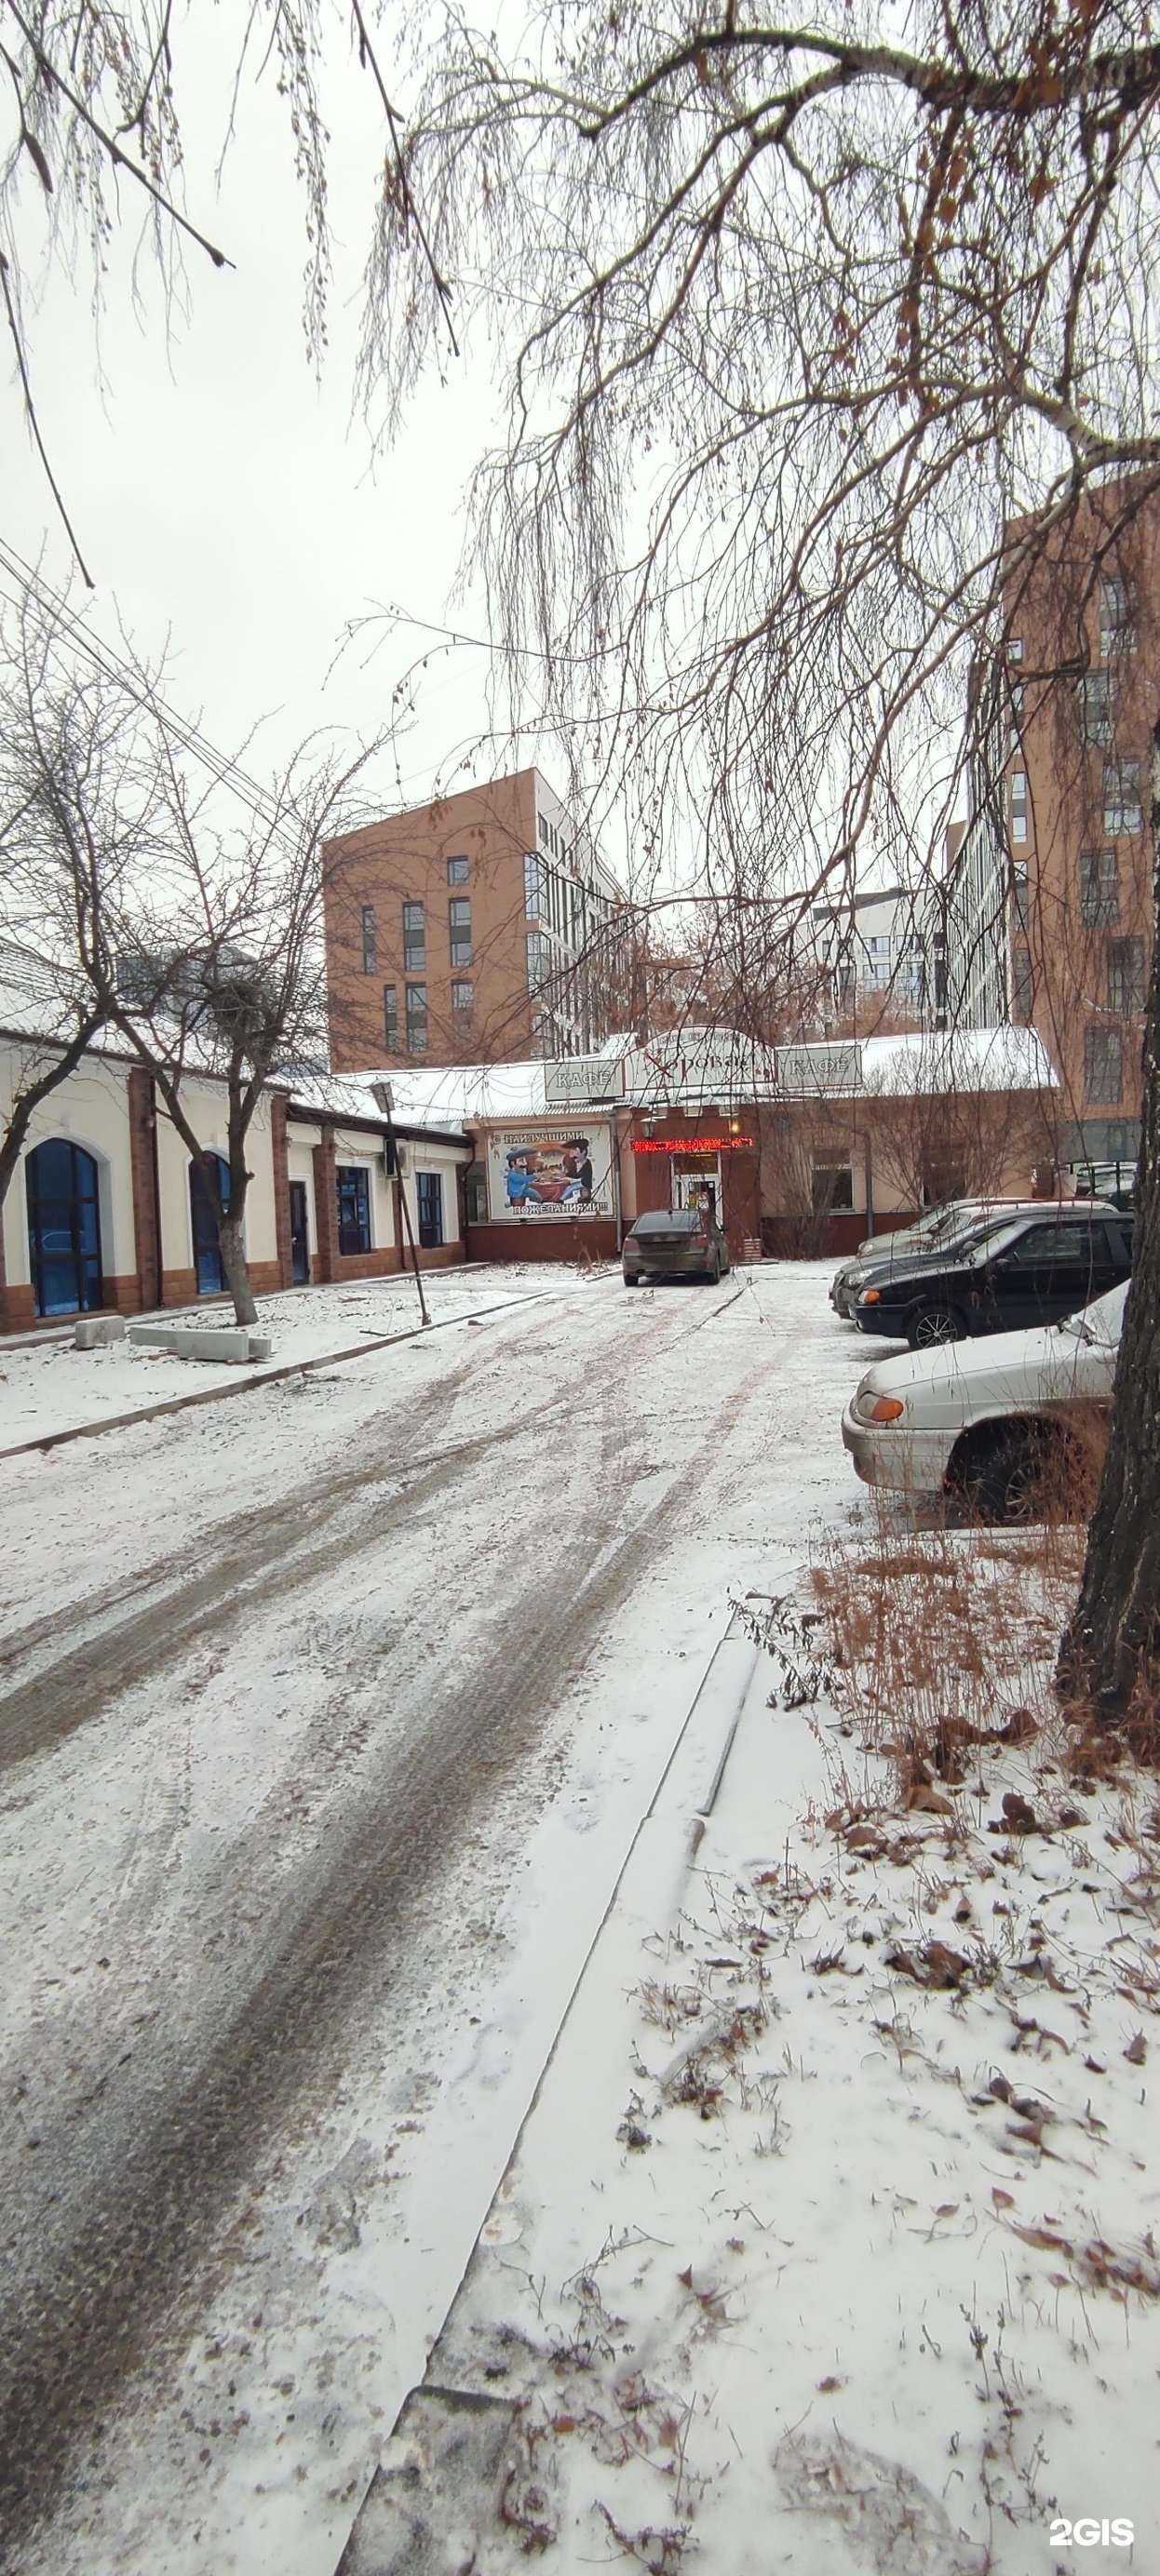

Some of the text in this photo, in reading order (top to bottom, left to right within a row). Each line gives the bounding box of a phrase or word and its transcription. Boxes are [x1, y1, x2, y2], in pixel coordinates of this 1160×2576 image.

[789, 1057, 849, 1075] КАФЕ
[557, 1071, 611, 1089] КАФЕ
[492, 1131, 584, 1146] С НАИЛУЧШИМИ
